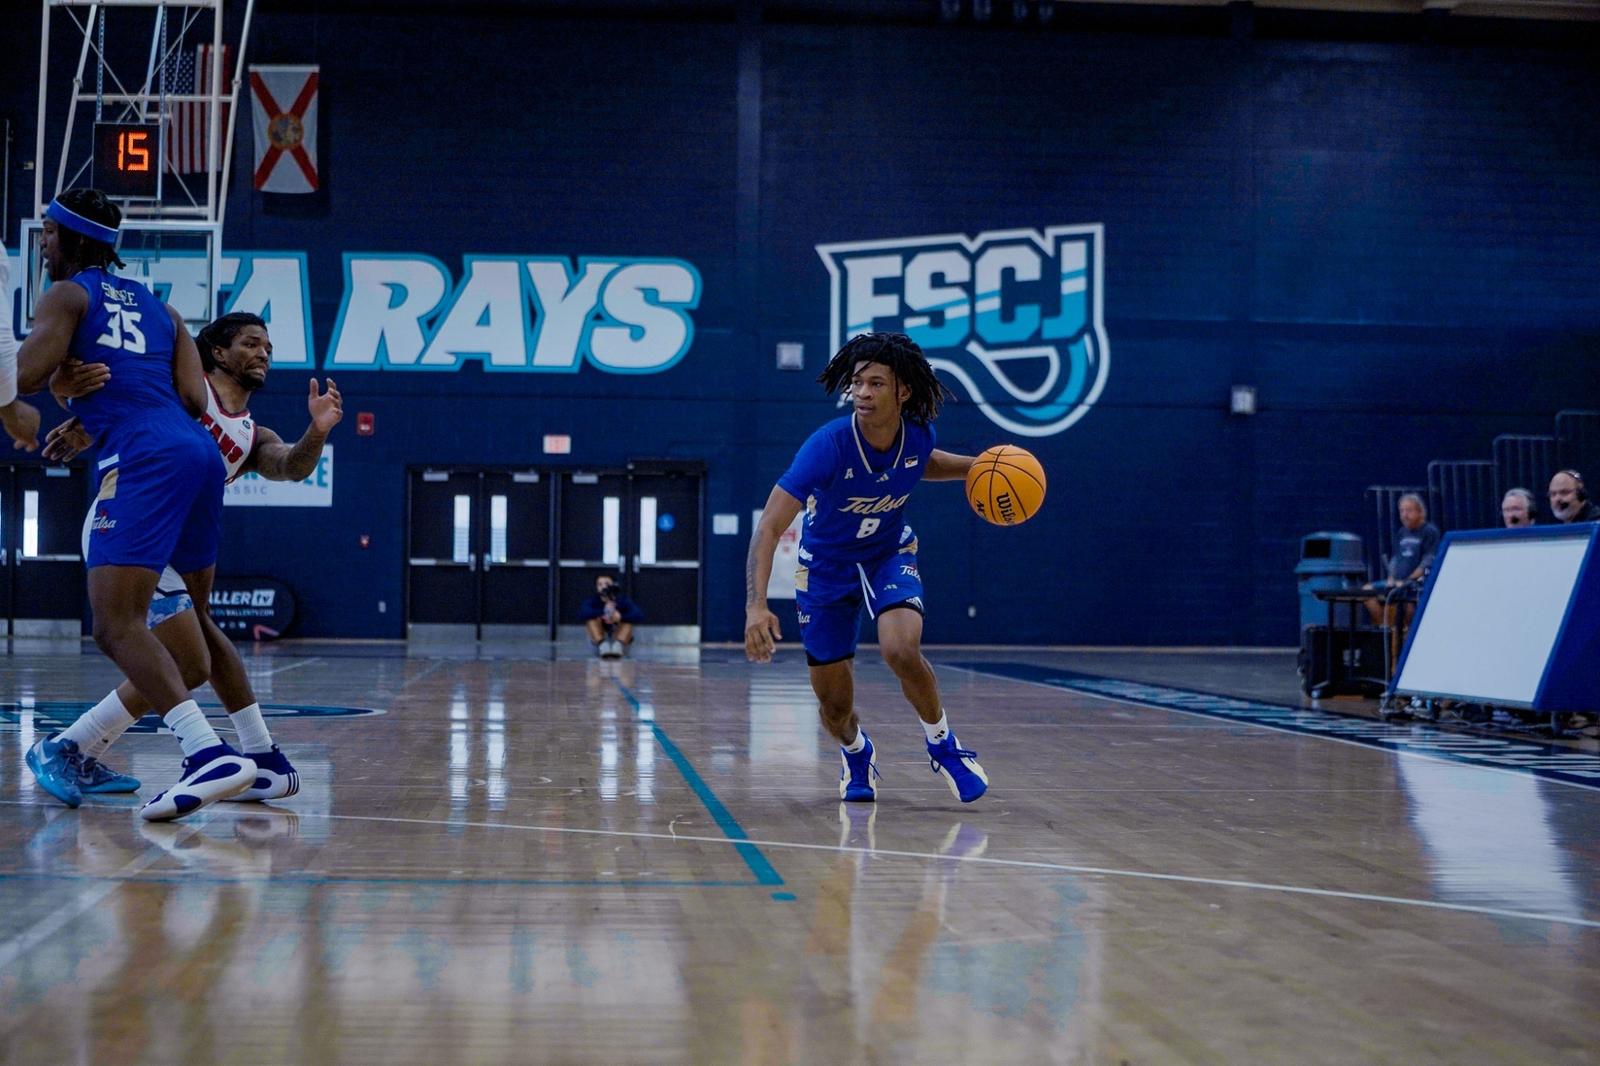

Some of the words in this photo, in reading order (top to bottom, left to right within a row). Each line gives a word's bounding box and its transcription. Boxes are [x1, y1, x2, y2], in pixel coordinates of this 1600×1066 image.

[117, 131, 150, 172] 15
[326, 253, 702, 374] RAYS
[842, 240, 1087, 349] FSCJ
[96, 302, 147, 354] 35
[226, 486, 268, 495] SSIC
[838, 493, 910, 515] Tulsa
[856, 518, 881, 539] 8
